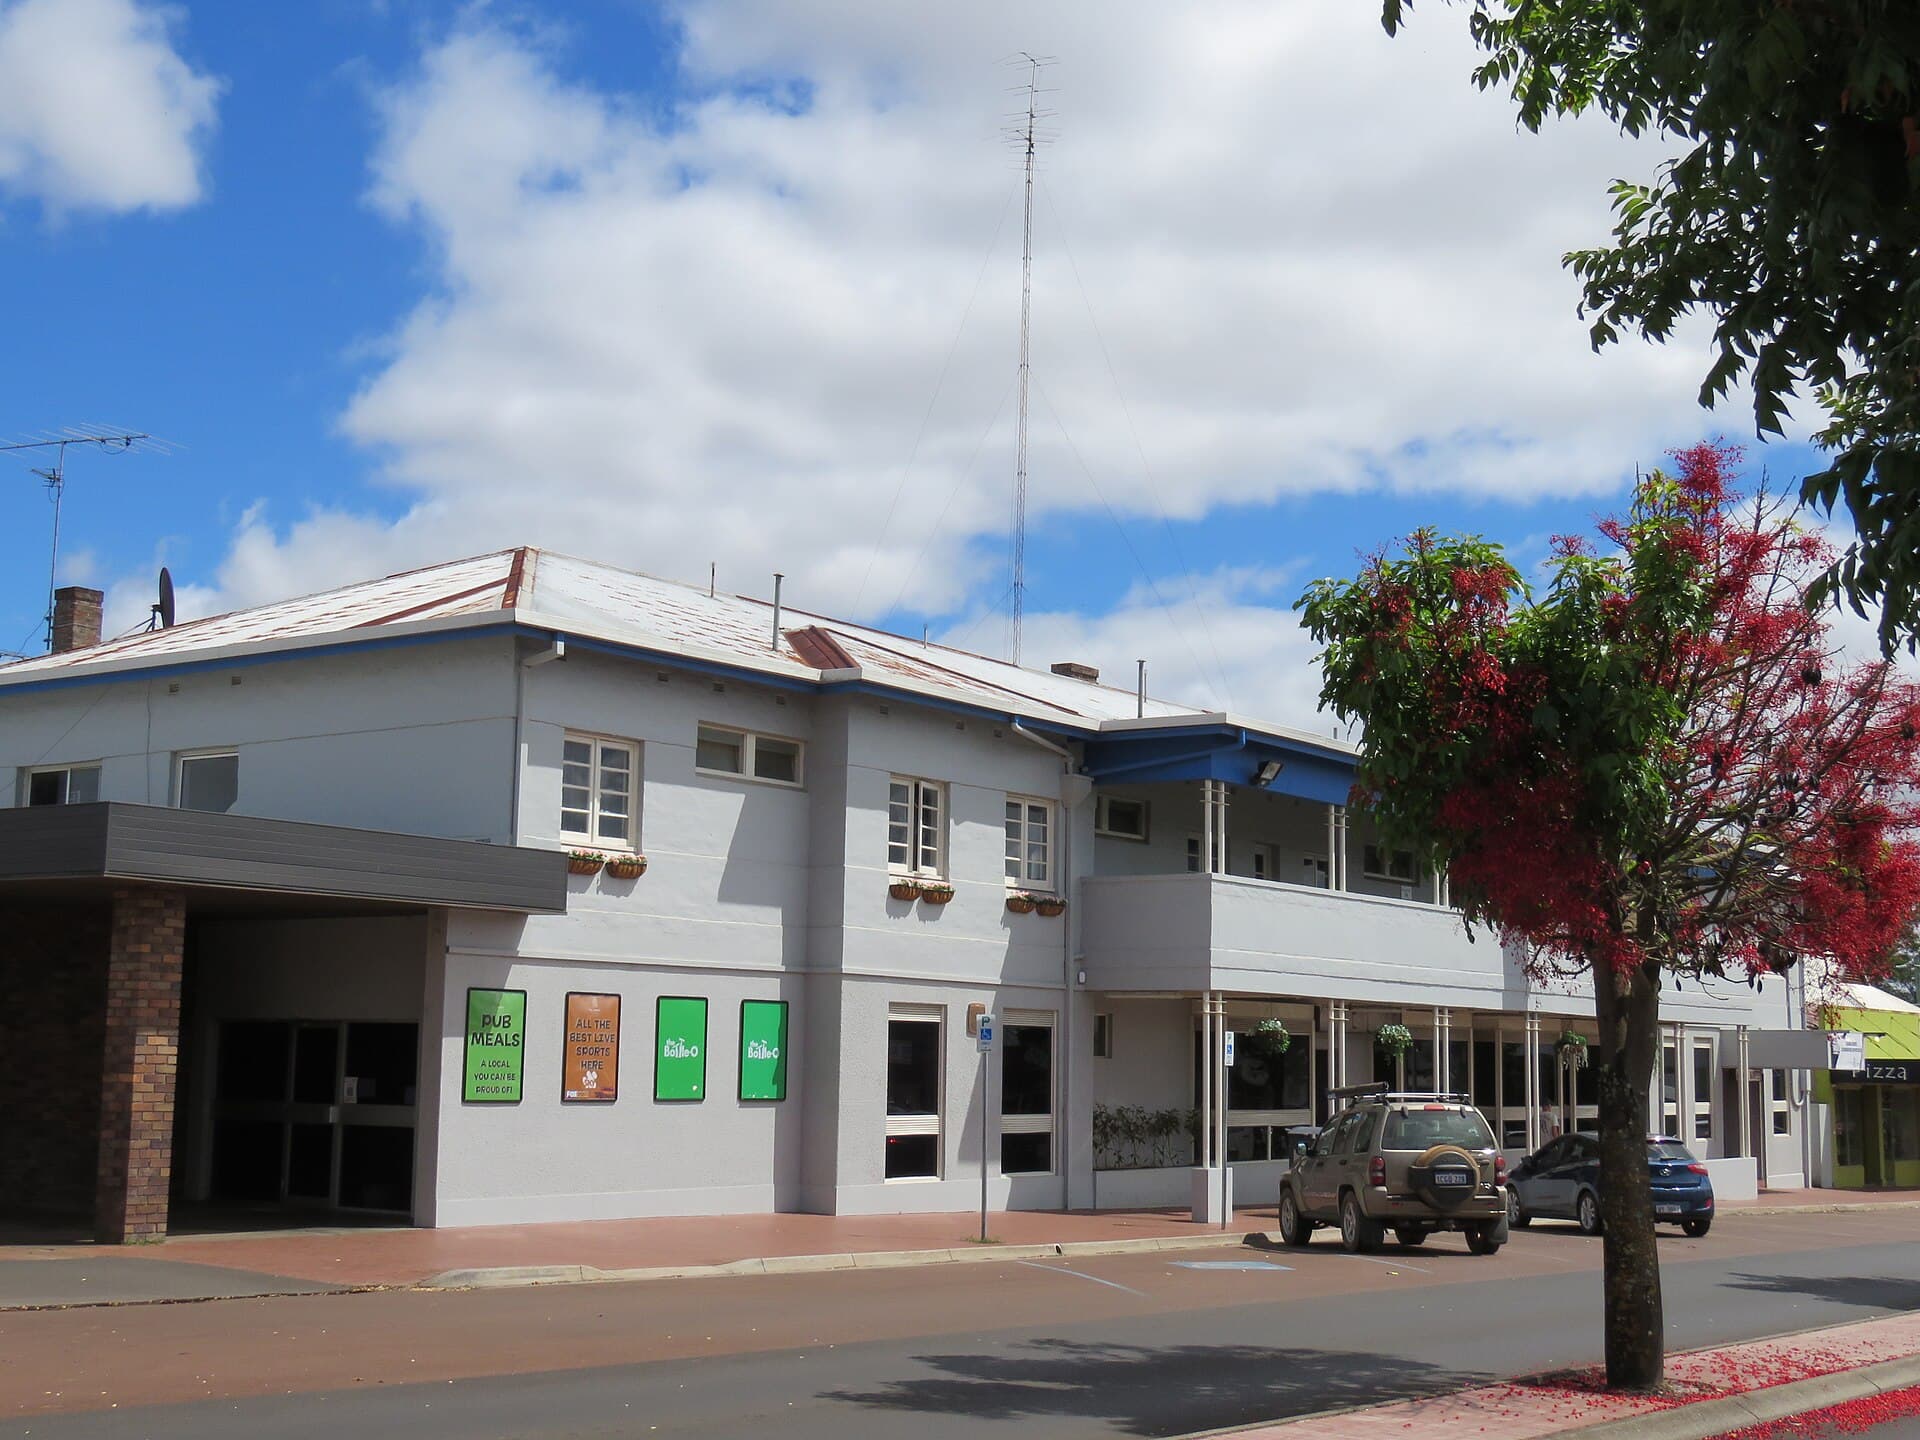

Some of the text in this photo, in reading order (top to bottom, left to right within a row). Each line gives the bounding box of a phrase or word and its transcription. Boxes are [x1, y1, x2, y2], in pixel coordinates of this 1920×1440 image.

[481, 1014, 512, 1029] PUB
[576, 1019, 611, 1029] ALL THE
[981, 1016, 991, 1027] P
[471, 1032, 520, 1047] MEALS
[569, 1032, 615, 1043] BEST LIVE
[576, 1046, 611, 1056] SPORTS
[481, 1060, 511, 1068] A LOCAL
[581, 1060, 604, 1070] HERE
[474, 1073, 516, 1081] YOU CAN BE
[475, 1086, 513, 1094] PROUD OF!
